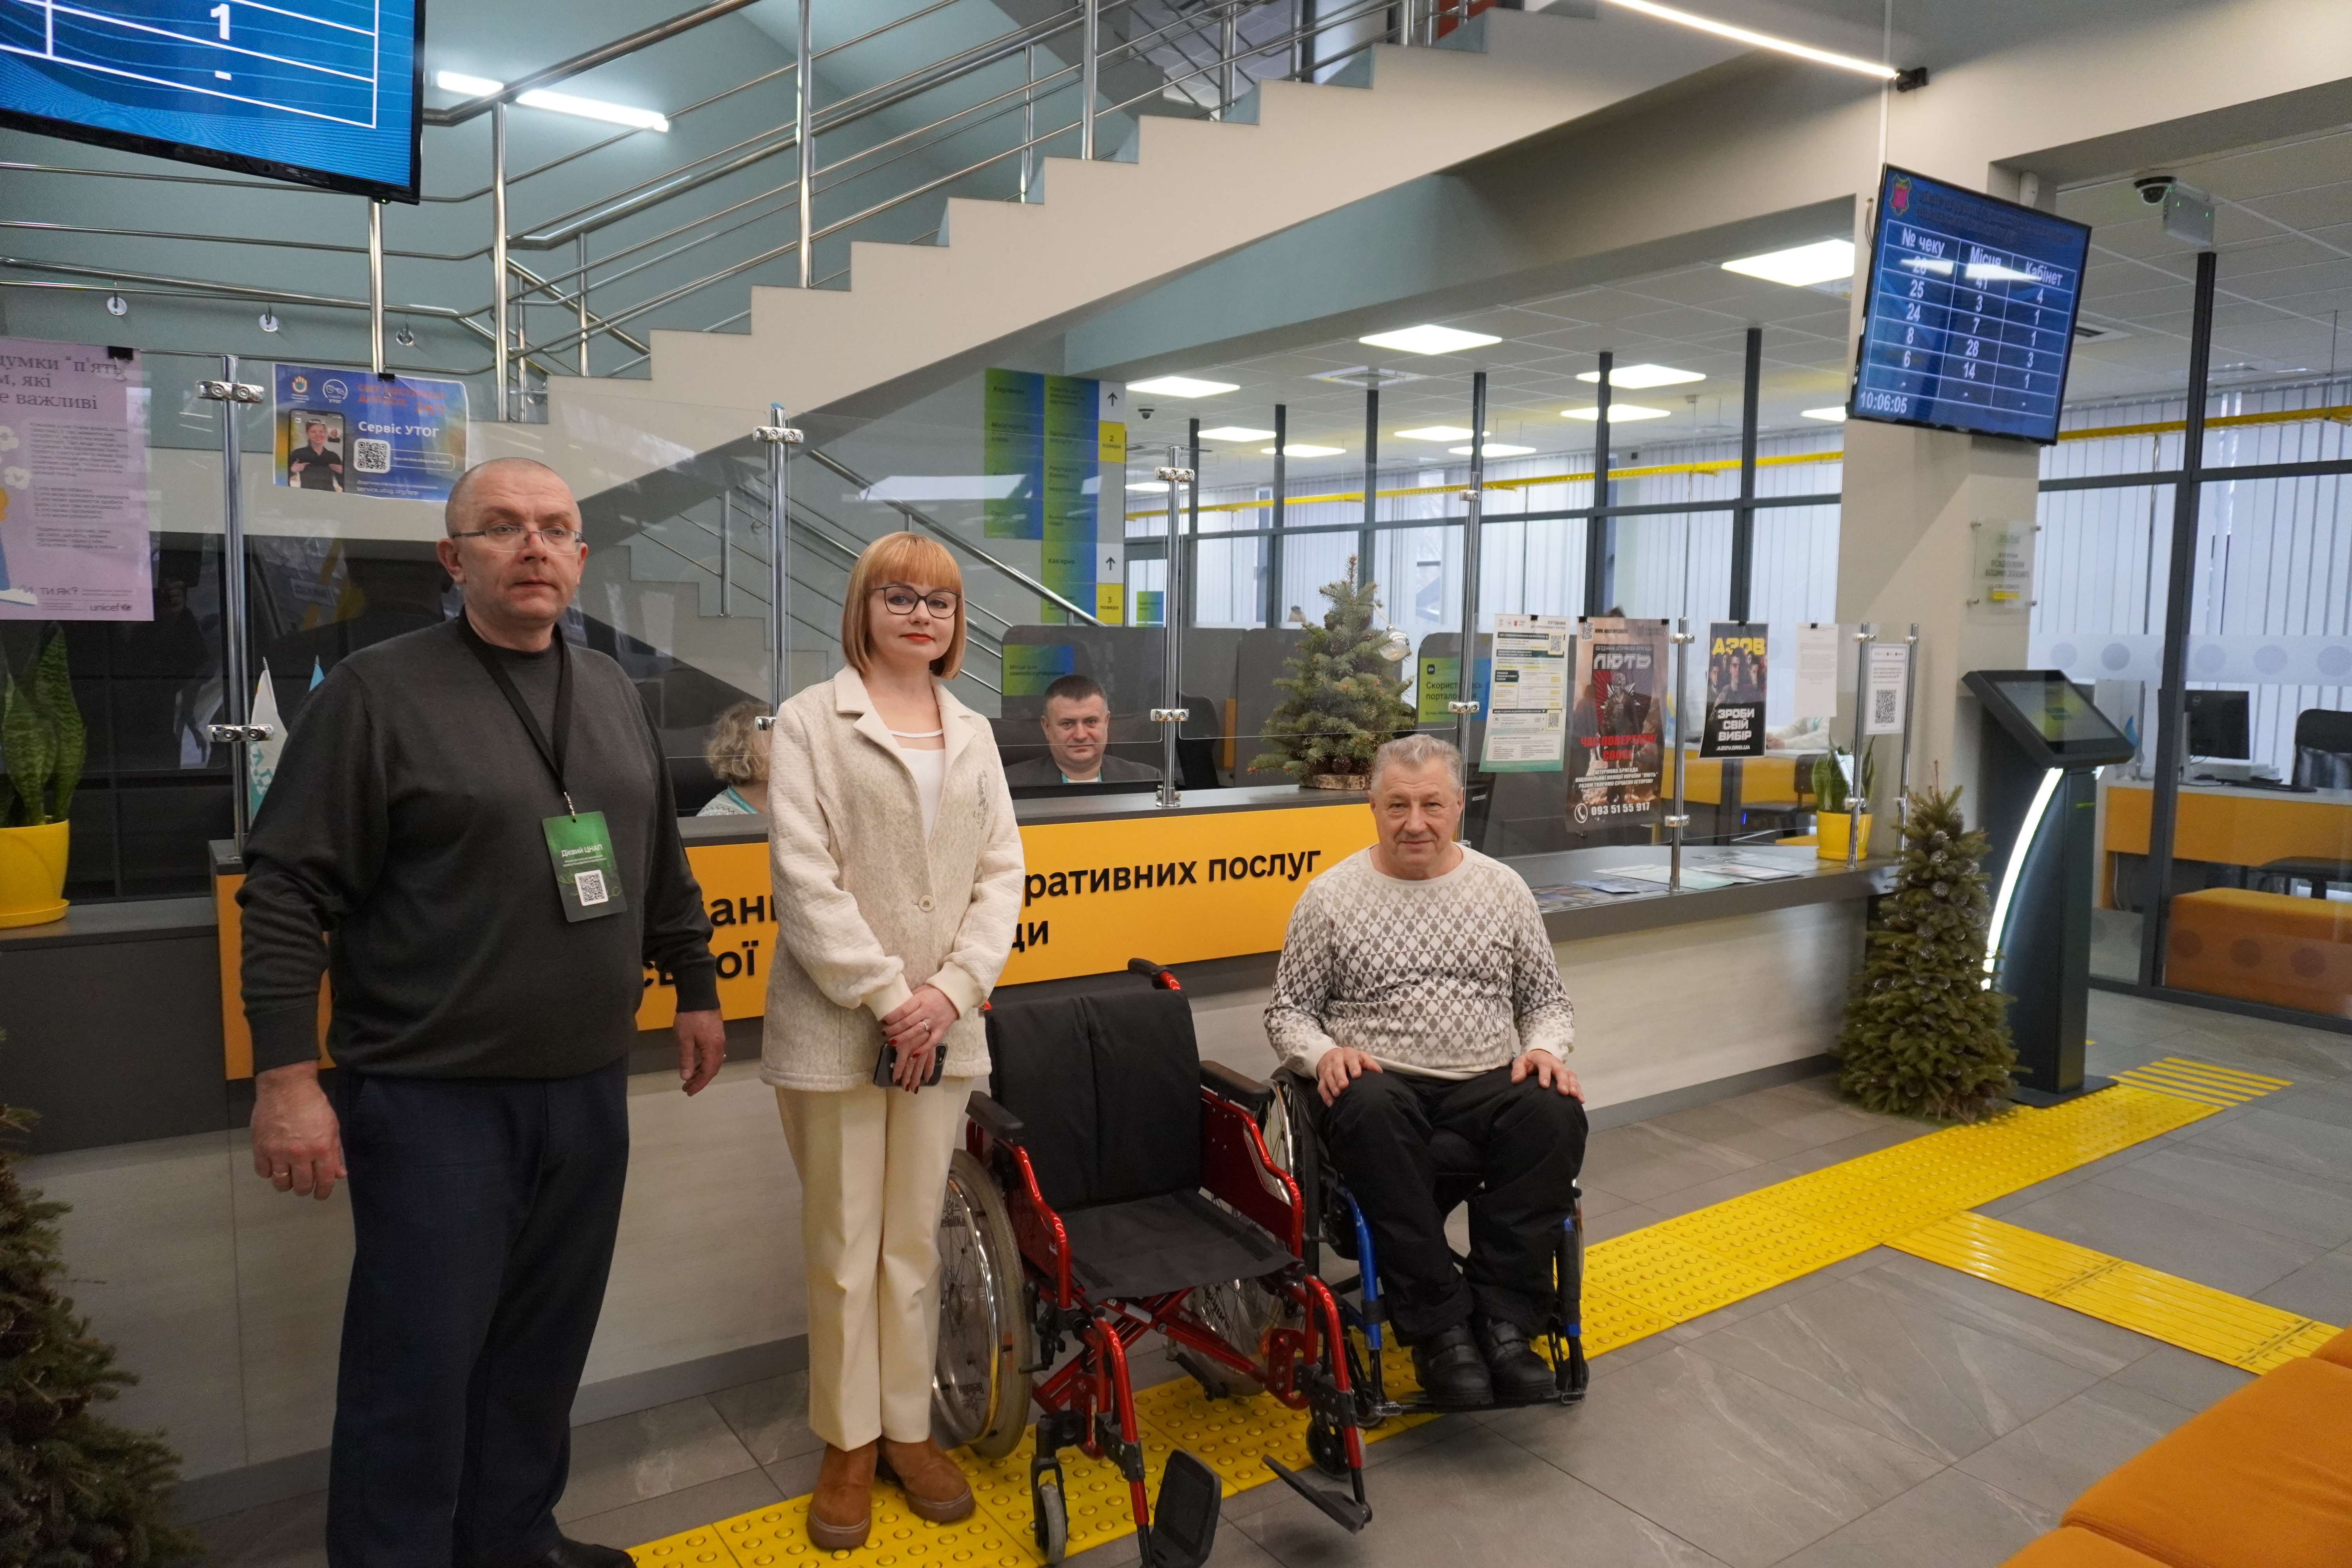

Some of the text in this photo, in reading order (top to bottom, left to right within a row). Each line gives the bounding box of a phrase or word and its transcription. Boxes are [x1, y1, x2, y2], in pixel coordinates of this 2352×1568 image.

[210, 4, 230, 40] 1
[1902, 227, 1915, 248] №
[1919, 235, 1945, 258] чеку
[2025, 261, 2063, 286] Кабінет
[1909, 279, 2040, 325] 25 3 1
[2036, 288, 2043, 303] 4
[1906, 302, 2037, 347] 24 7 1
[1907, 327, 2033, 368] 8 28 3
[1904, 350, 2030, 389] 6 14 1
[22, 374, 51, 387] які
[16, 394, 98, 409] важливі
[1860, 390, 1908, 414] 10:06:05
[358, 421, 439, 437] Сервіс УТОГ
[357, 487, 419, 495] service.utog.org/app
[1712, 637, 1766, 655] АЗОВ
[1594, 653, 1651, 669] ЛЮТЬ
[1718, 708, 1755, 719] ЗРОБИ
[1723, 718, 1749, 730] СВІЙ
[1580, 734, 1654, 747] ЧАС ПОВЕРТАТИ
[1718, 731, 1752, 741] ВИБІР
[1591, 802, 1650, 816] 093 51 55 917
[562, 844, 603, 857] Дієвий ЦНАП
[1024, 861, 1197, 907] ративних
[1209, 850, 1321, 883] послуг
